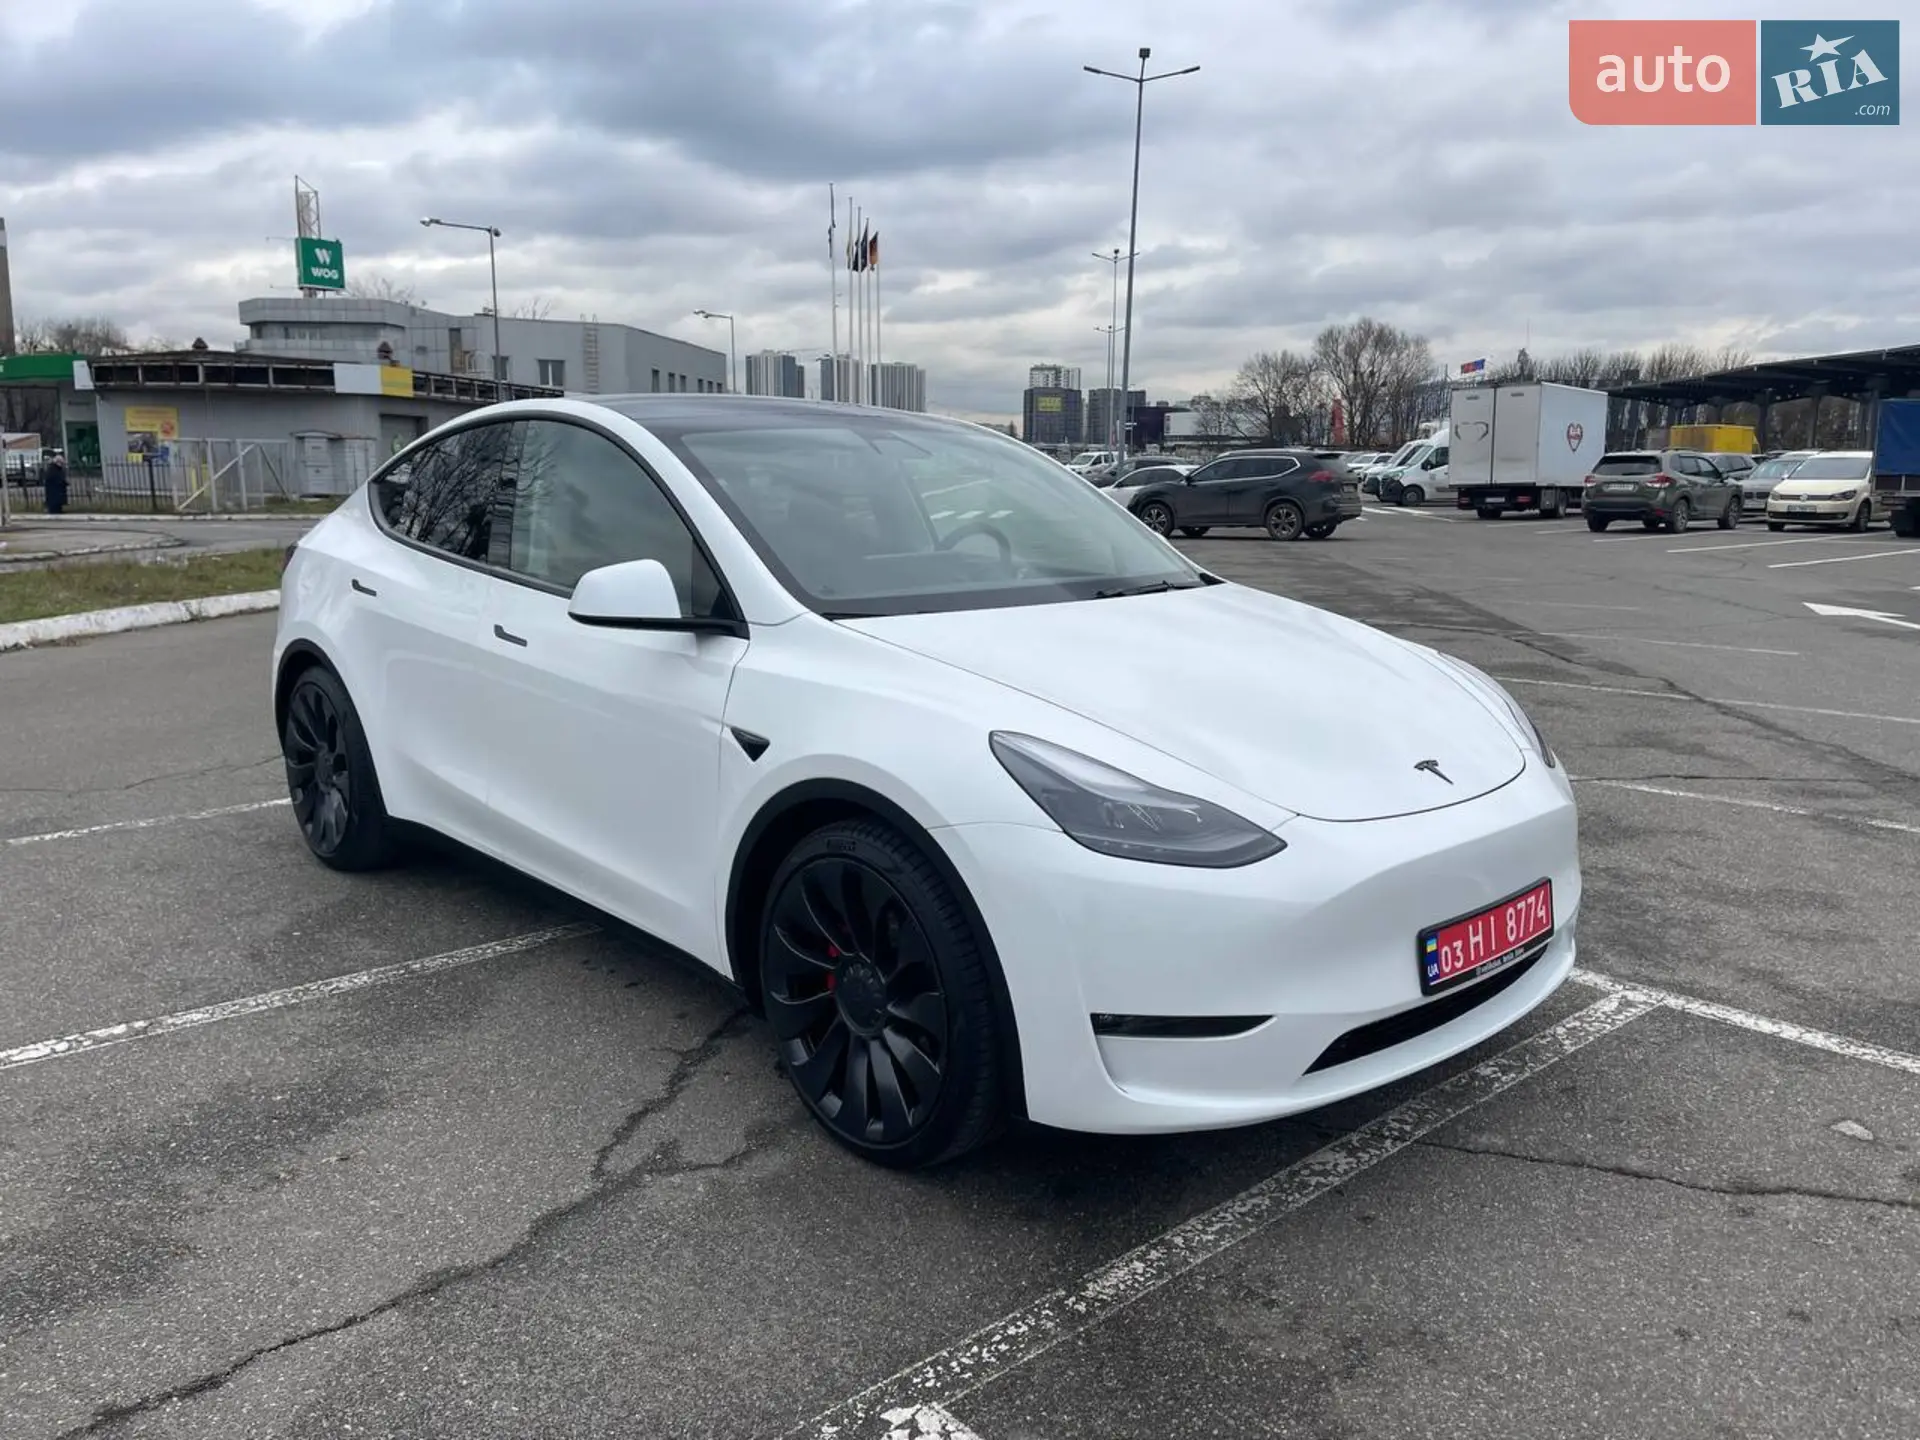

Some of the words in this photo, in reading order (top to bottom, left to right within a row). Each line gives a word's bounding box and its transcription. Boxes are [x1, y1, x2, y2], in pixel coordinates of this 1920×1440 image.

[311, 267, 338, 279] WOG
[1441, 940, 1464, 973] 03
[1468, 915, 1497, 961] HI
[1506, 890, 1546, 943] 8774
[1428, 963, 1439, 977] UA
